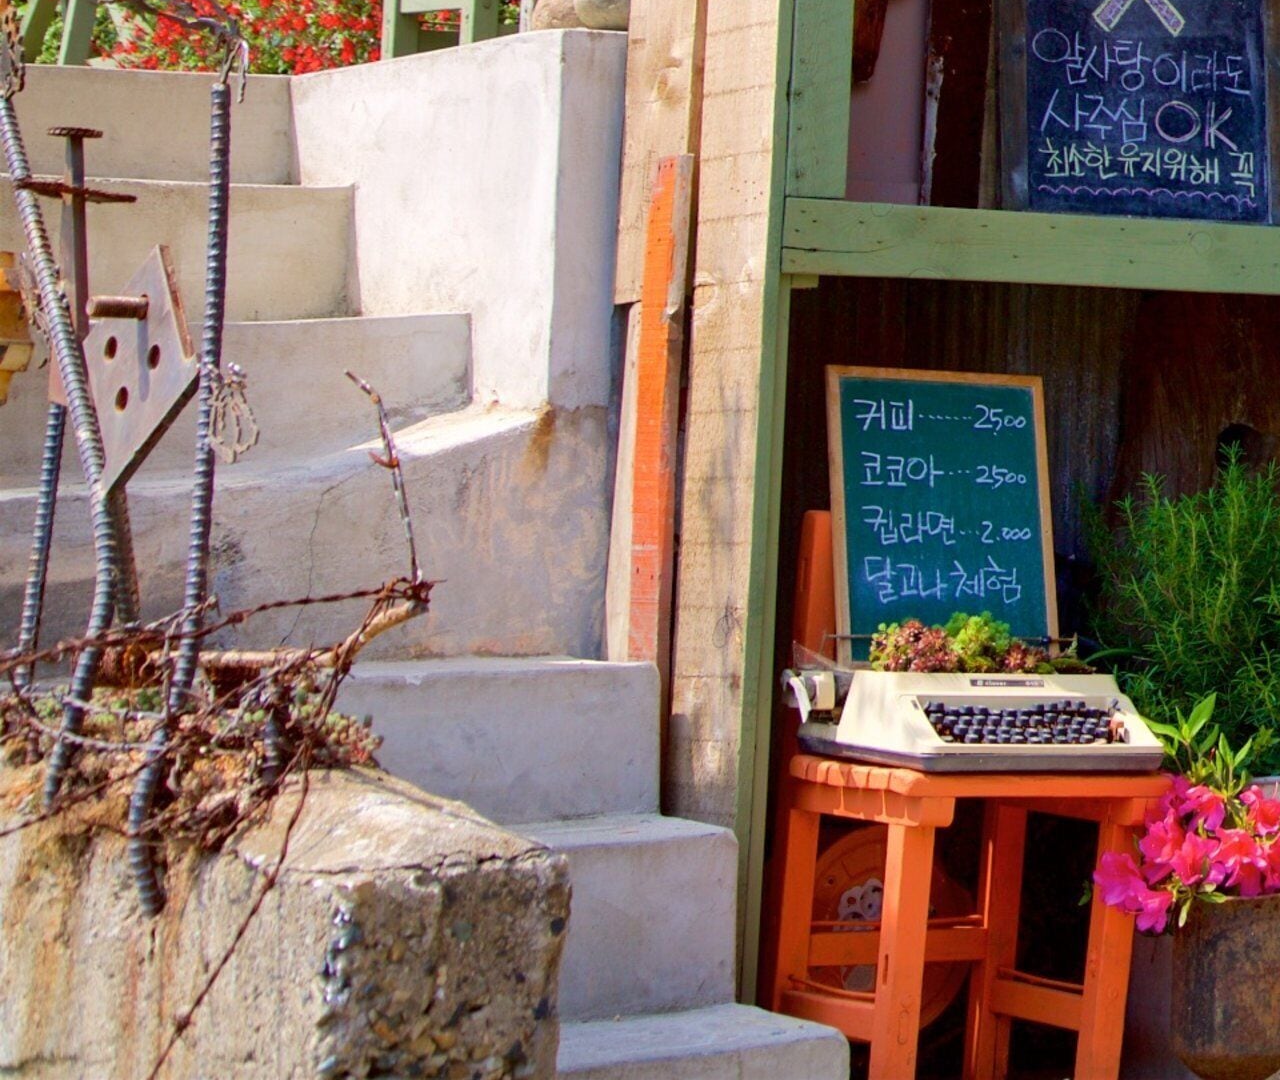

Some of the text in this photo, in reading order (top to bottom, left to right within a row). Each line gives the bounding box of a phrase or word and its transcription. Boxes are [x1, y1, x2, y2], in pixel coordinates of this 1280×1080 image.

[1154, 99, 1239, 152] OK
[1227, 150, 1256, 199] 꼭
[852, 398, 914, 432] 커피
[859, 450, 945, 489] 코코아
